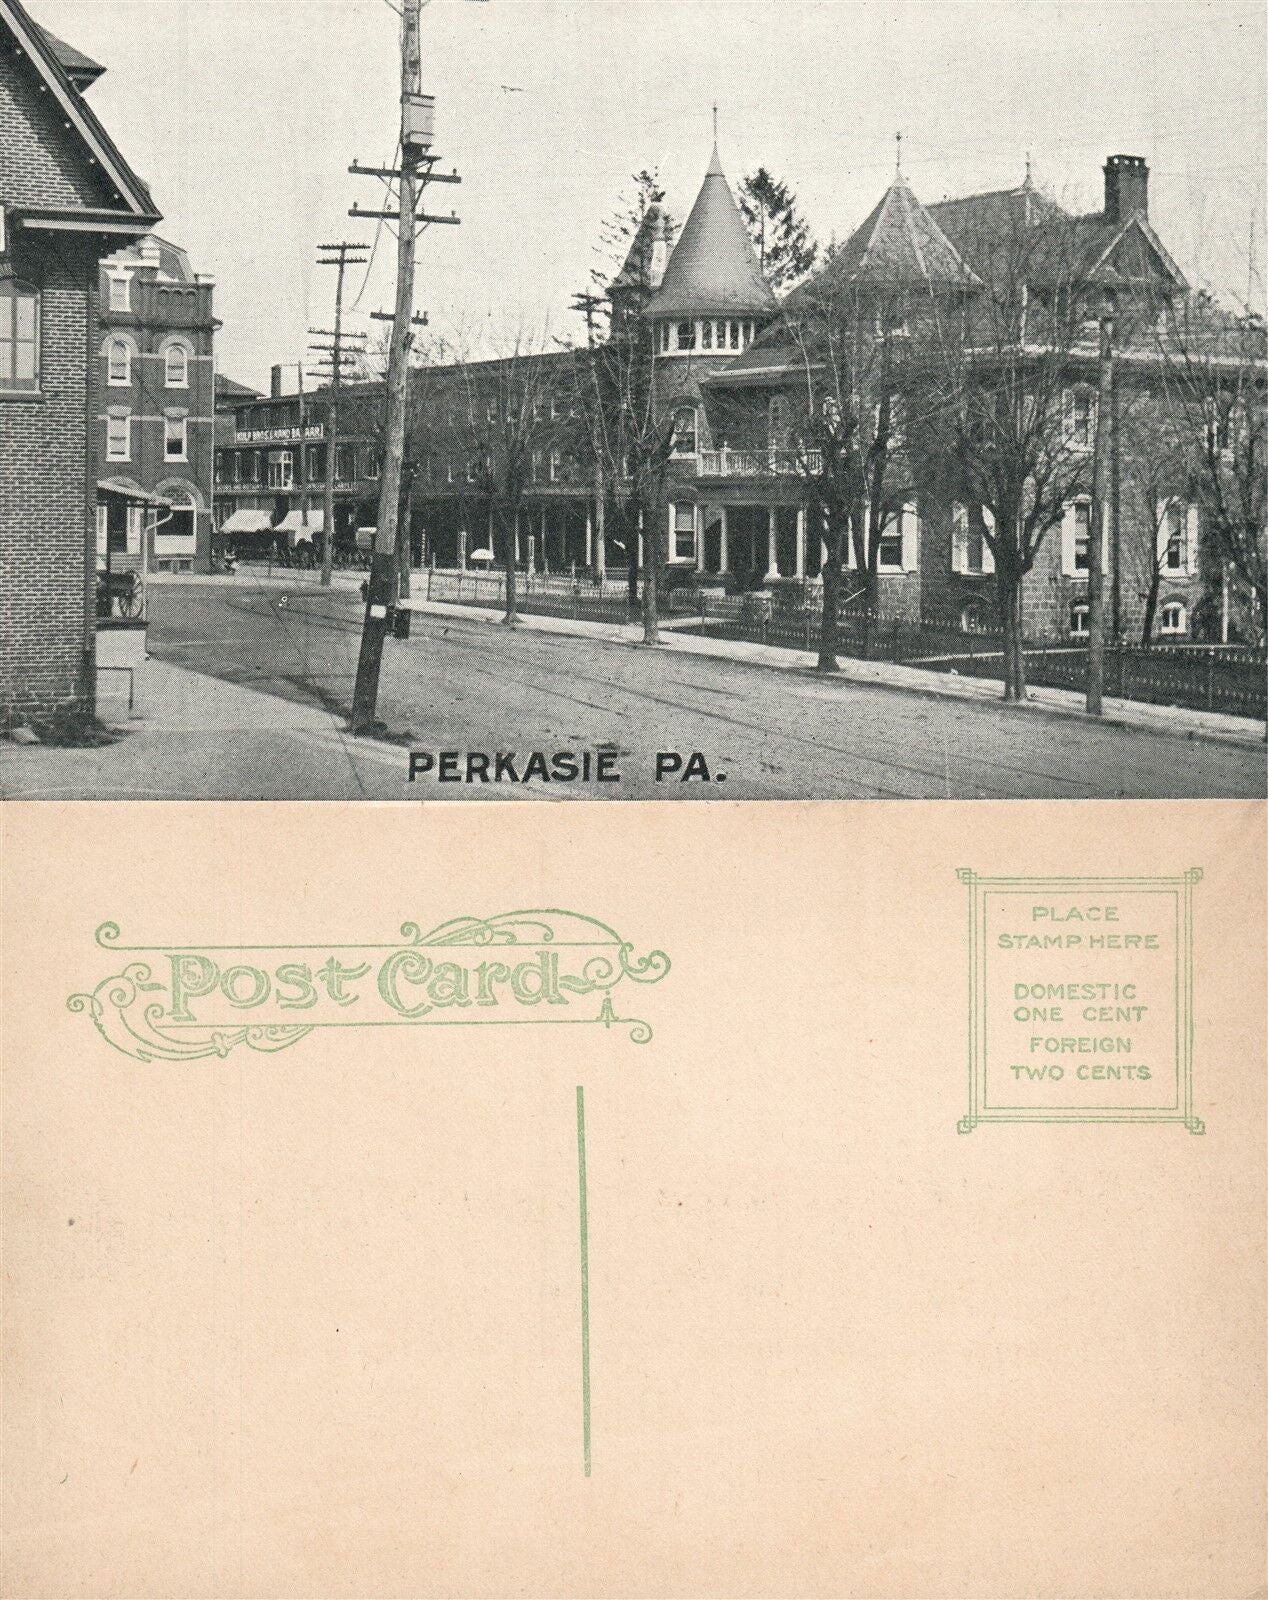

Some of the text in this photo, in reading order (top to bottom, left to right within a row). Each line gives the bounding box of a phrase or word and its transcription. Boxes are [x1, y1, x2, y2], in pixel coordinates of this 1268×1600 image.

[291, 426, 320, 438] BAAAR
[1032, 906, 1120, 922] PLACE
[998, 933, 1160, 950] STAMP HERE
[164, 950, 570, 1021] Post Card
[1013, 983, 1137, 1000] DOMESTIC
[1013, 1006, 1148, 1022] ONE CENT
[1030, 1036, 1132, 1053] FOREIGN
[1010, 1064, 1152, 1081] TWO CENTS
